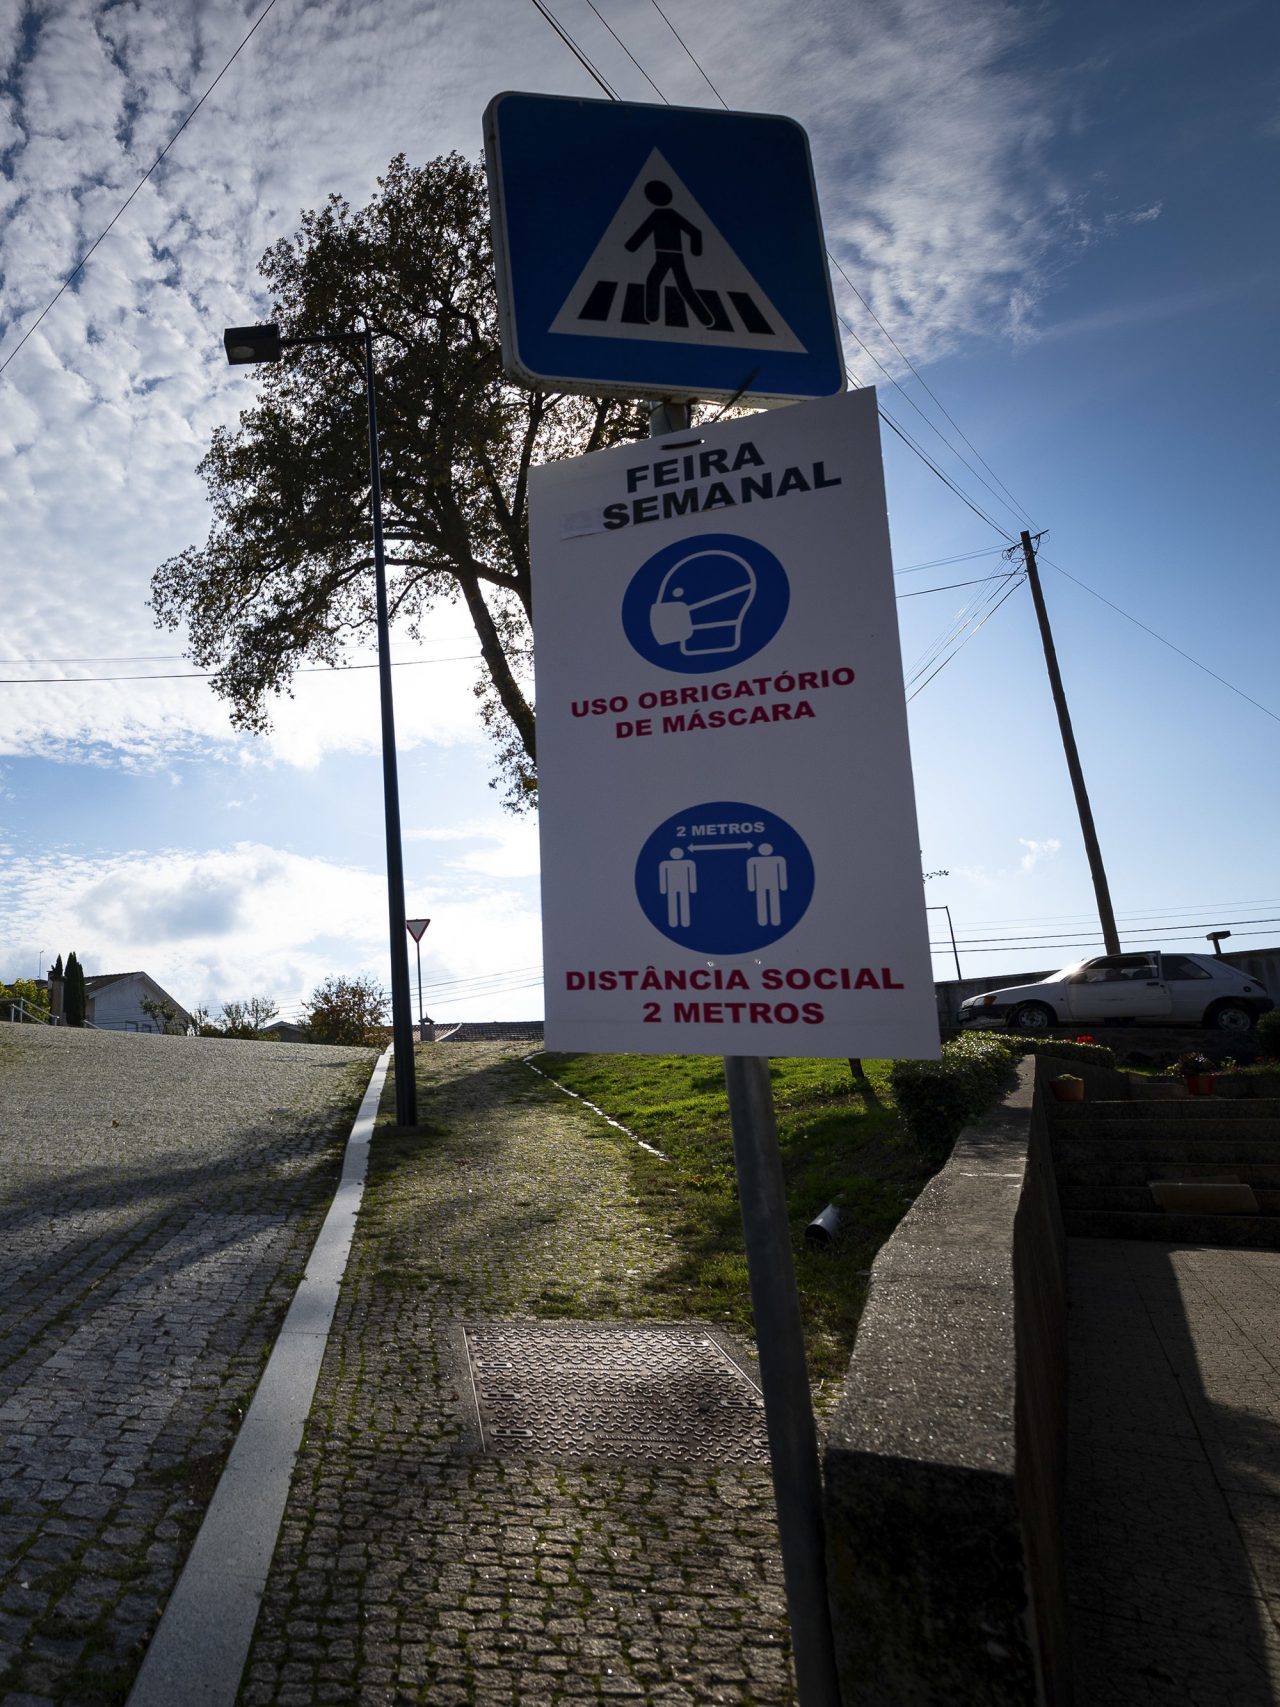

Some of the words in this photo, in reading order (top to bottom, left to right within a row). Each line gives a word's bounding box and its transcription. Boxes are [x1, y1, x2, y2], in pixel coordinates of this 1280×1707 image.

[626, 441, 765, 493] FEIRA
[602, 461, 842, 531] SEMANAL
[571, 694, 628, 718] USO
[638, 666, 856, 710] OBRIGATÓRIO
[615, 718, 653, 739] DE
[662, 700, 816, 735] MÁSCARA
[676, 826, 687, 837] 2
[691, 821, 766, 836] METROS
[566, 965, 750, 991] DISTÂNCIA
[761, 967, 905, 990] SOCIAL
[642, 1003, 662, 1023] 2
[673, 1002, 825, 1025] METROS
